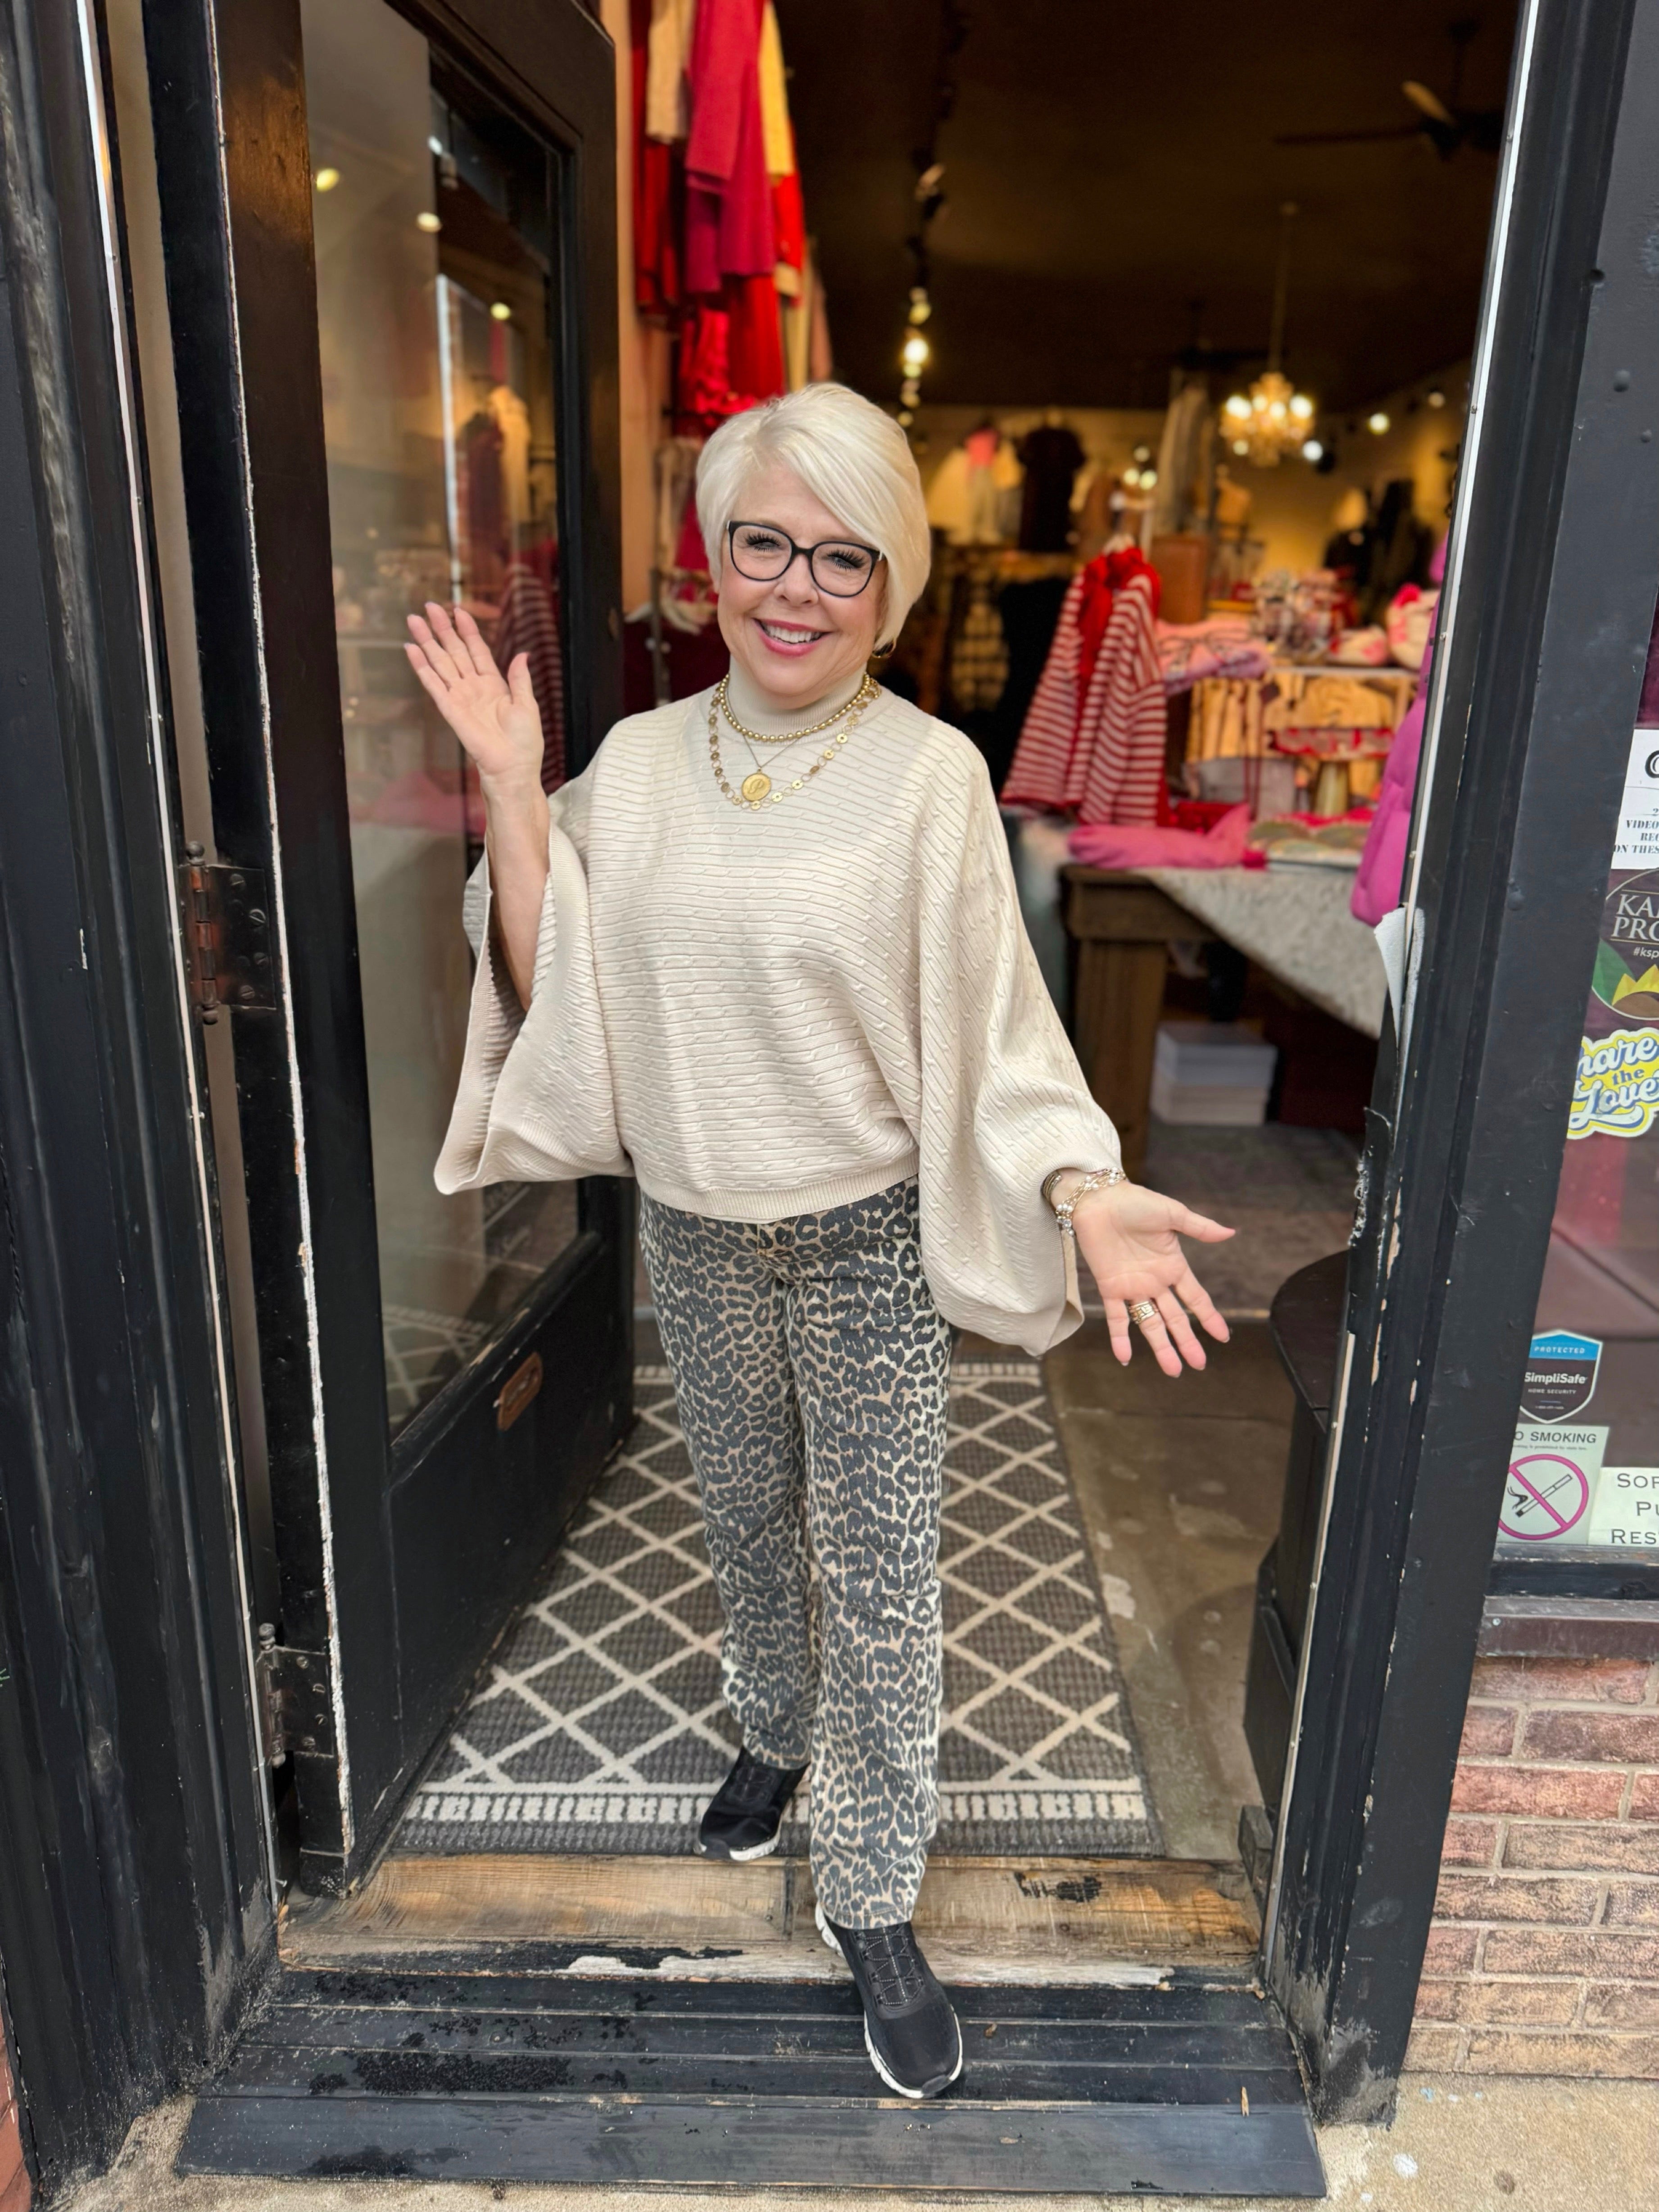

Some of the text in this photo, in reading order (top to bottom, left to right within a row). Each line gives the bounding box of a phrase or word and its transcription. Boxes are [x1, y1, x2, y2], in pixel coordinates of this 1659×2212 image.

[1627, 820, 1659, 829] VIDEO
[1616, 894, 1659, 918] KA
[1577, 1037, 1659, 1078] hare
[1612, 1069, 1645, 1085] the
[1534, 1346, 1586, 1354] PROTECTED
[1524, 1372, 1586, 1385] SimpliSafe
[1514, 1431, 1597, 1444] O SMOKING
